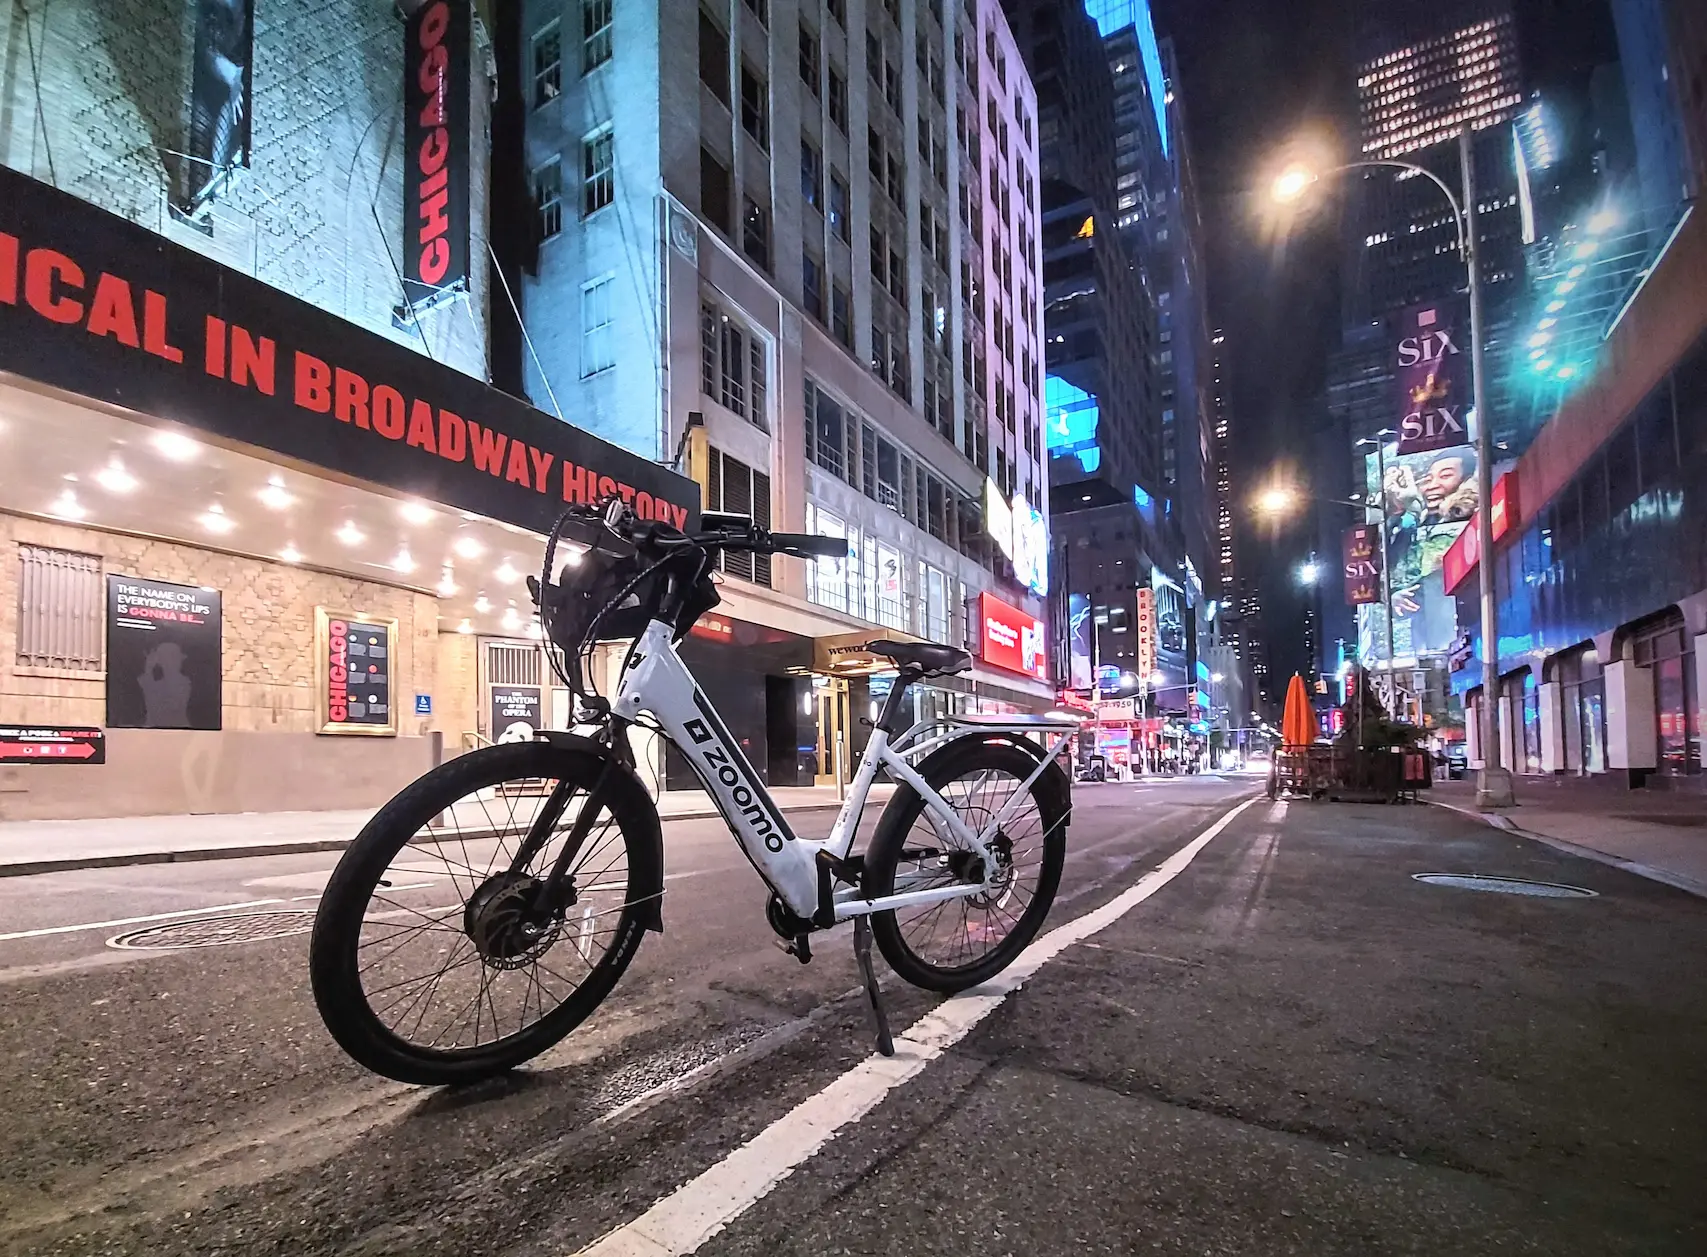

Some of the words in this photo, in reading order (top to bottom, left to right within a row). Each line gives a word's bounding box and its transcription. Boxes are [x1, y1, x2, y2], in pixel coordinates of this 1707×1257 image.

[419, 1, 450, 284] CHICAGO
[0, 231, 183, 364] ICAL
[205, 315, 275, 396] IN
[294, 350, 554, 493] BROADWAY
[562, 460, 689, 535] HISTORY
[117, 584, 139, 595] THE
[141, 588, 174, 600] NAME
[177, 593, 196, 604] ON
[117, 594, 189, 611] EVERYBODY'S
[191, 604, 210, 615] LIPS
[117, 604, 128, 614] IS
[129, 607, 177, 620] GONNA
[1140, 591, 1148, 679] BROOKLYN
[329, 620, 347, 722] CHICAGO
[495, 695, 538, 705] PHANTOM
[502, 708, 532, 717] OPERA
[702, 746, 784, 853] zoomo
